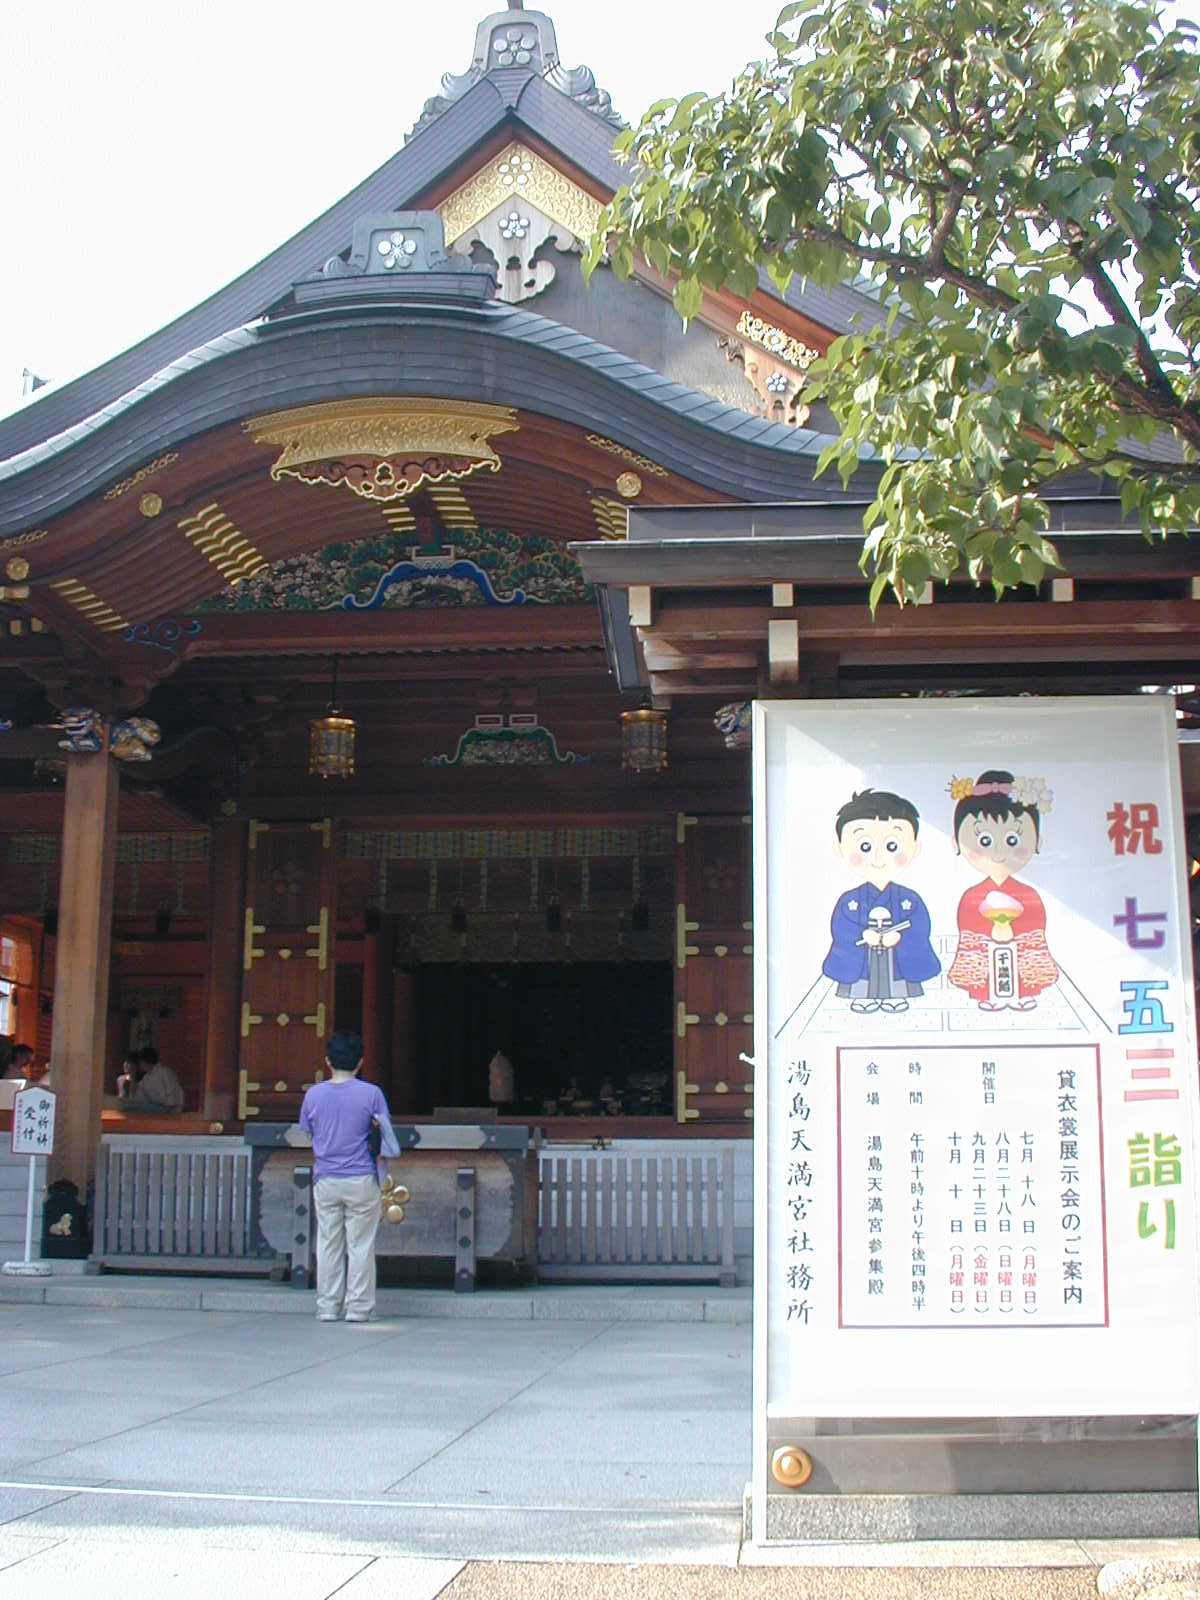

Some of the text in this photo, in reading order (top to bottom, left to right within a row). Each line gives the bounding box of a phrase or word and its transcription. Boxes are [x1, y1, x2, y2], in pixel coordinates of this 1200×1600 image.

[982, 1061, 996, 1104] 開催日
[1106, 802, 1182, 1250] 祝七五三詣り
[787, 1060, 815, 1325] 湯島天満宮社務所
[866, 1062, 884, 1295] 会場 湯島天満宮参集殿
[908, 1061, 926, 1311] 時間 午前十時より午後四時半
[1057, 1069, 1083, 1305] 貸衣裳展示会のご案内
